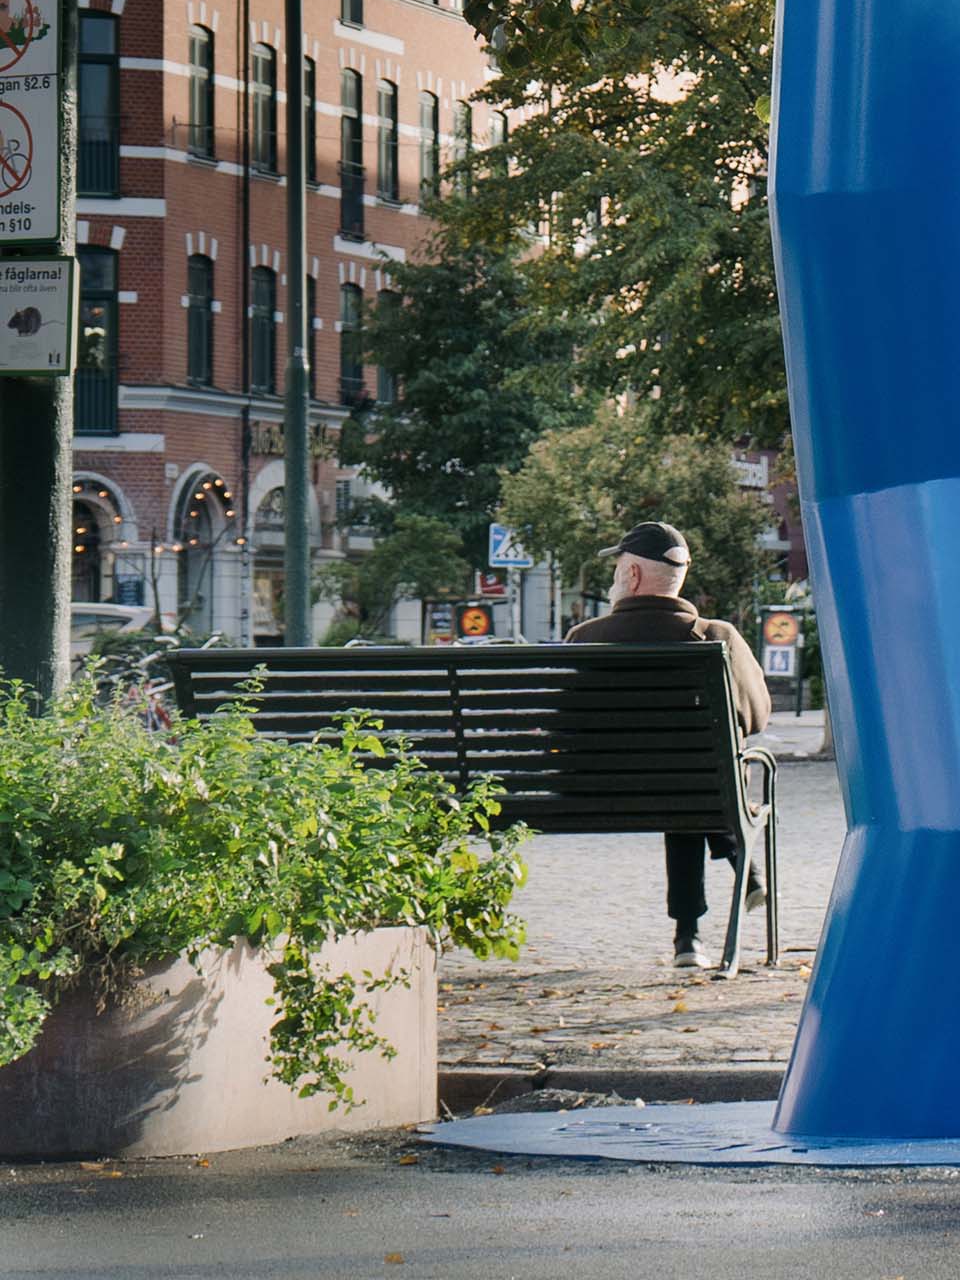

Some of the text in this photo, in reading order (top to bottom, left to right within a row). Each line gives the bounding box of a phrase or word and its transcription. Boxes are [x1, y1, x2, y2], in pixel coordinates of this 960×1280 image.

[24, 76, 50, 91] §2.6
[9, 217, 32, 233] §10
[5, 267, 62, 284] fåglarna!
